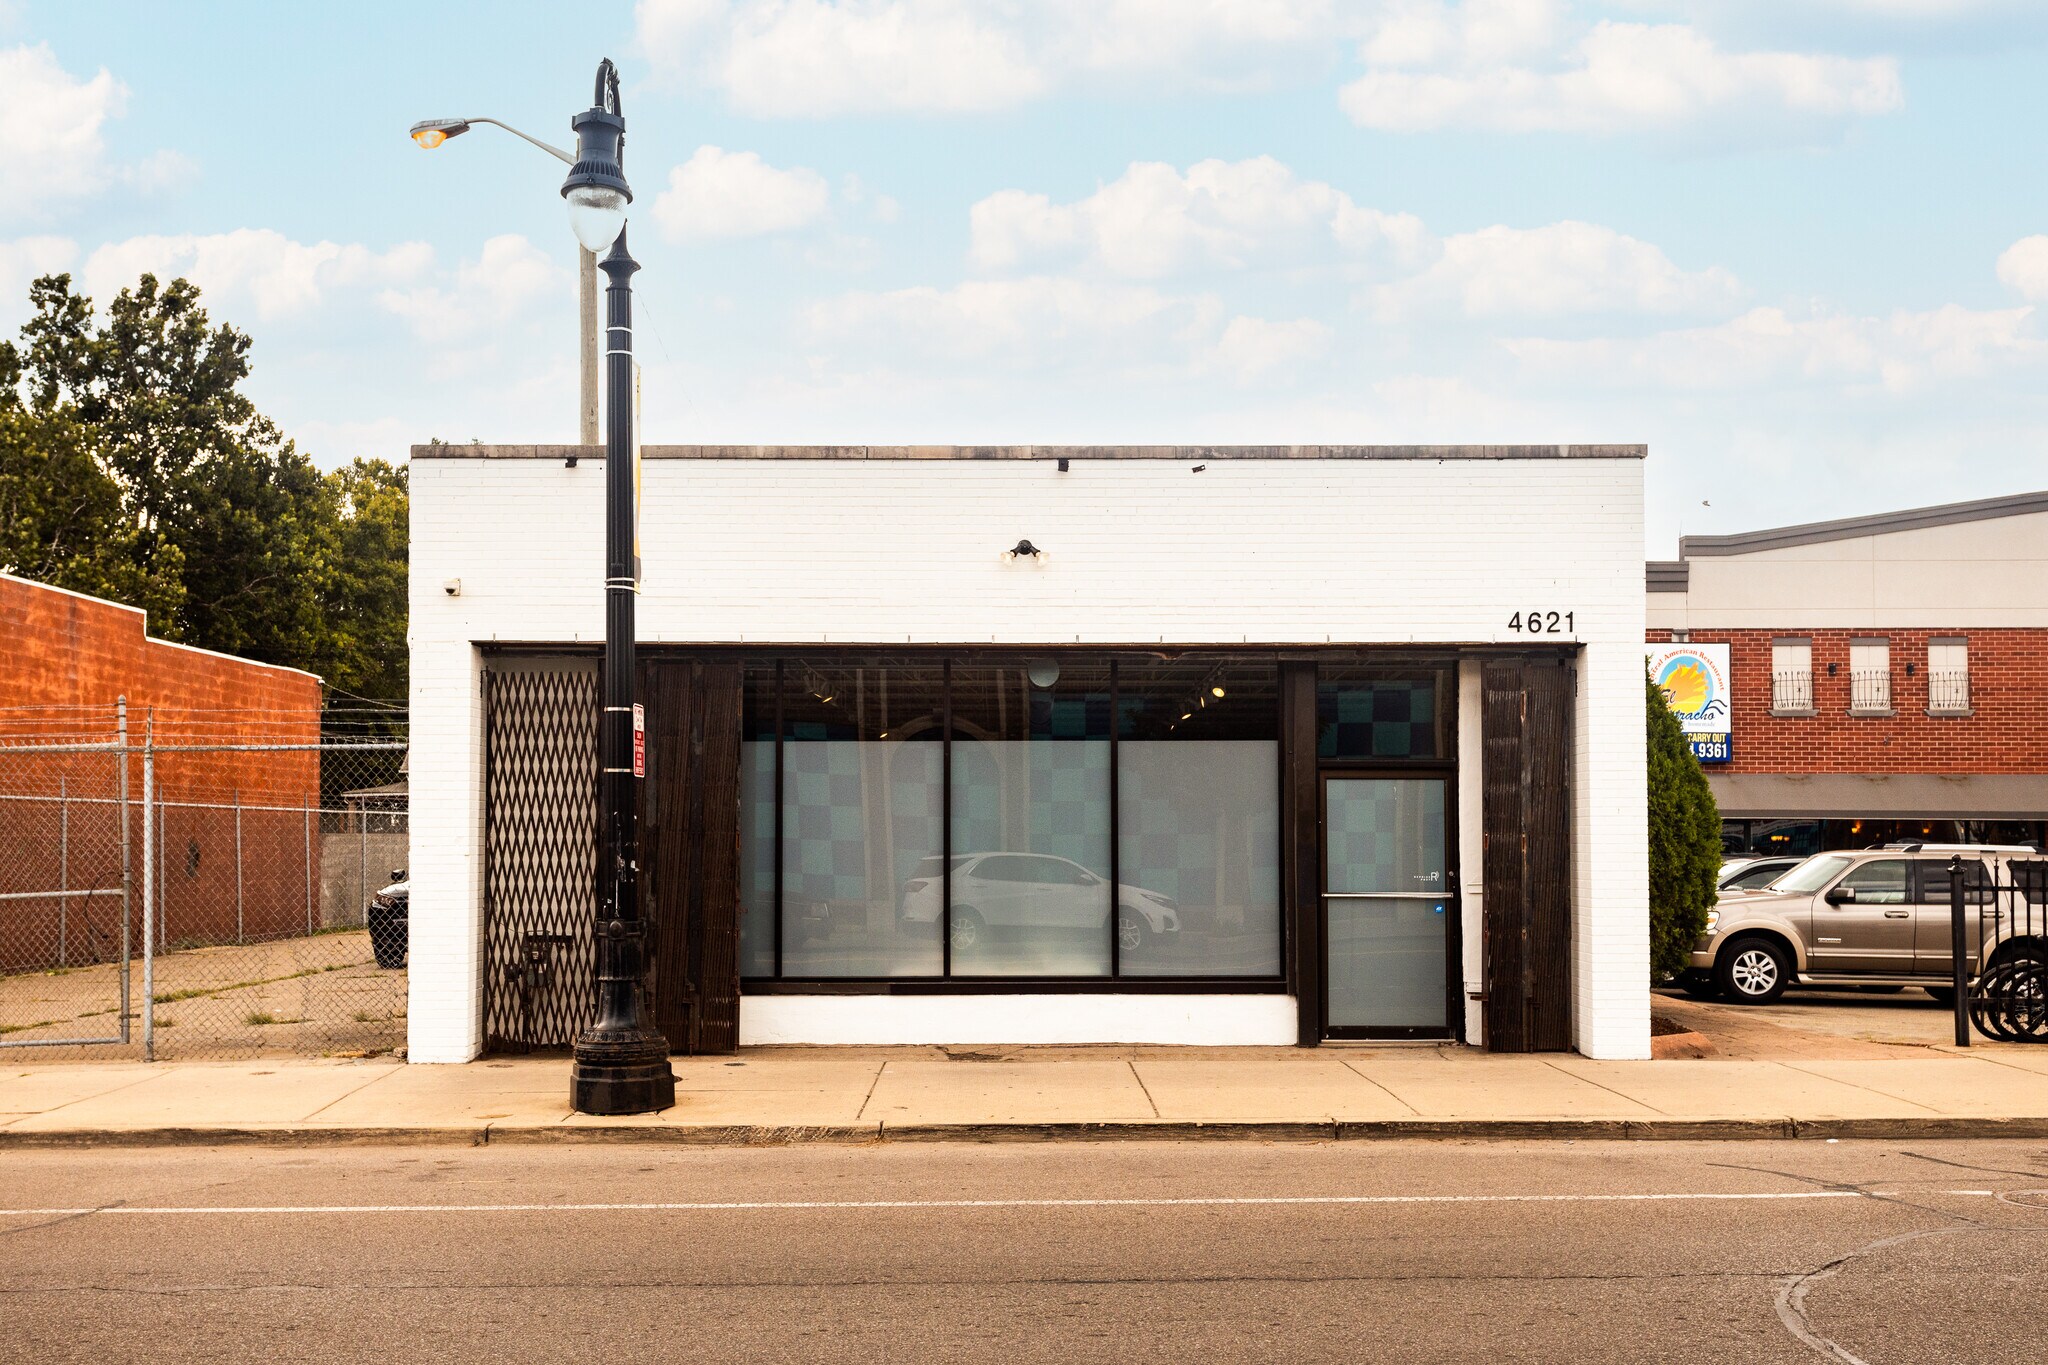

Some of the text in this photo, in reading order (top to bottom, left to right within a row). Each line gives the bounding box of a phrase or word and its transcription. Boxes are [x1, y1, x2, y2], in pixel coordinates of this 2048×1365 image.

[1508, 611, 1573, 633] 4621
[1650, 648, 1725, 691] ntral American Restaurant
[1674, 700, 1716, 721] tracho
[1712, 733, 1726, 743] OUT
